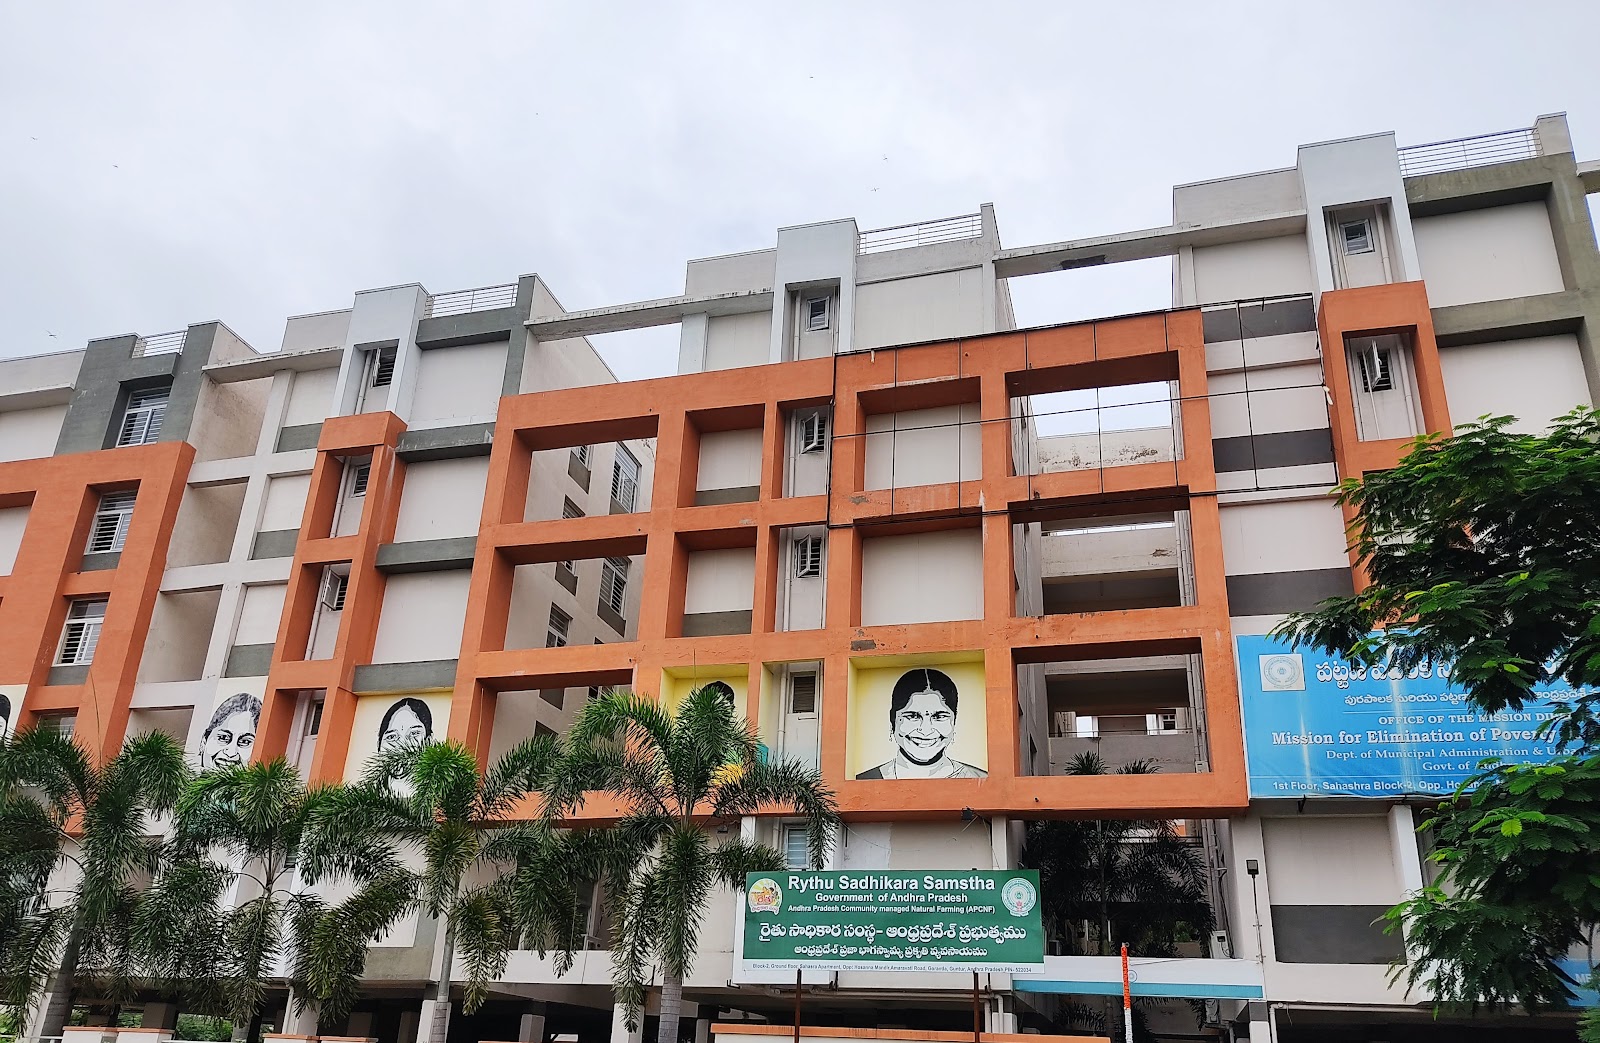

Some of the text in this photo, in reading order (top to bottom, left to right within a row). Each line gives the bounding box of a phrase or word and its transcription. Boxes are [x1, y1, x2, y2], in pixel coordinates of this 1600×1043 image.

[1378, 715, 1424, 725] OFFICE
[1427, 715, 1444, 724] OF
[1448, 714, 1475, 723] THE
[1478, 713, 1531, 723] MISSION
[1272, 731, 1335, 745] Mission
[1338, 730, 1363, 744] for
[1366, 728, 1464, 744] Elimination
[1470, 727, 1487, 742] of
[1326, 750, 1358, 761] Dept.
[1360, 750, 1372, 759] of
[1375, 748, 1435, 760] Municipal
[1439, 746, 1529, 757] Administration
[1532, 747, 1544, 756] &
[1422, 761, 1455, 771] Govt.
[1458, 761, 1470, 770] of
[1273, 782, 1289, 790] 1st
[1291, 782, 1320, 791] Floor,
[1322, 781, 1371, 790] Sahashra
[1418, 781, 1443, 791] Opp.
[788, 875, 995, 893] Rythu Sadhikara Samstha
[815, 892, 968, 903] Government of Andhra Pradesh
[788, 904, 811, 912] Andhra
[813, 904, 839, 912] Pradesh
[841, 904, 878, 914] Community
[879, 905, 910, 914] managed
[911, 905, 935, 913] Natural
[937, 905, 965, 914] Farming
[966, 905, 995, 914] (APCNF)
[759, 922, 787, 942] రైతు
[789, 923, 841, 939] సాధికార
[885, 922, 957, 942] ఆంధ్రప్రదేశ్
[959, 924, 1027, 944] ప్రభుత్వము
[794, 943, 988, 960] ఆంధ్రప్రదేశ్ ప్రజా భాగస్వామ్య ప్రకృతి వ్యవసాయము
